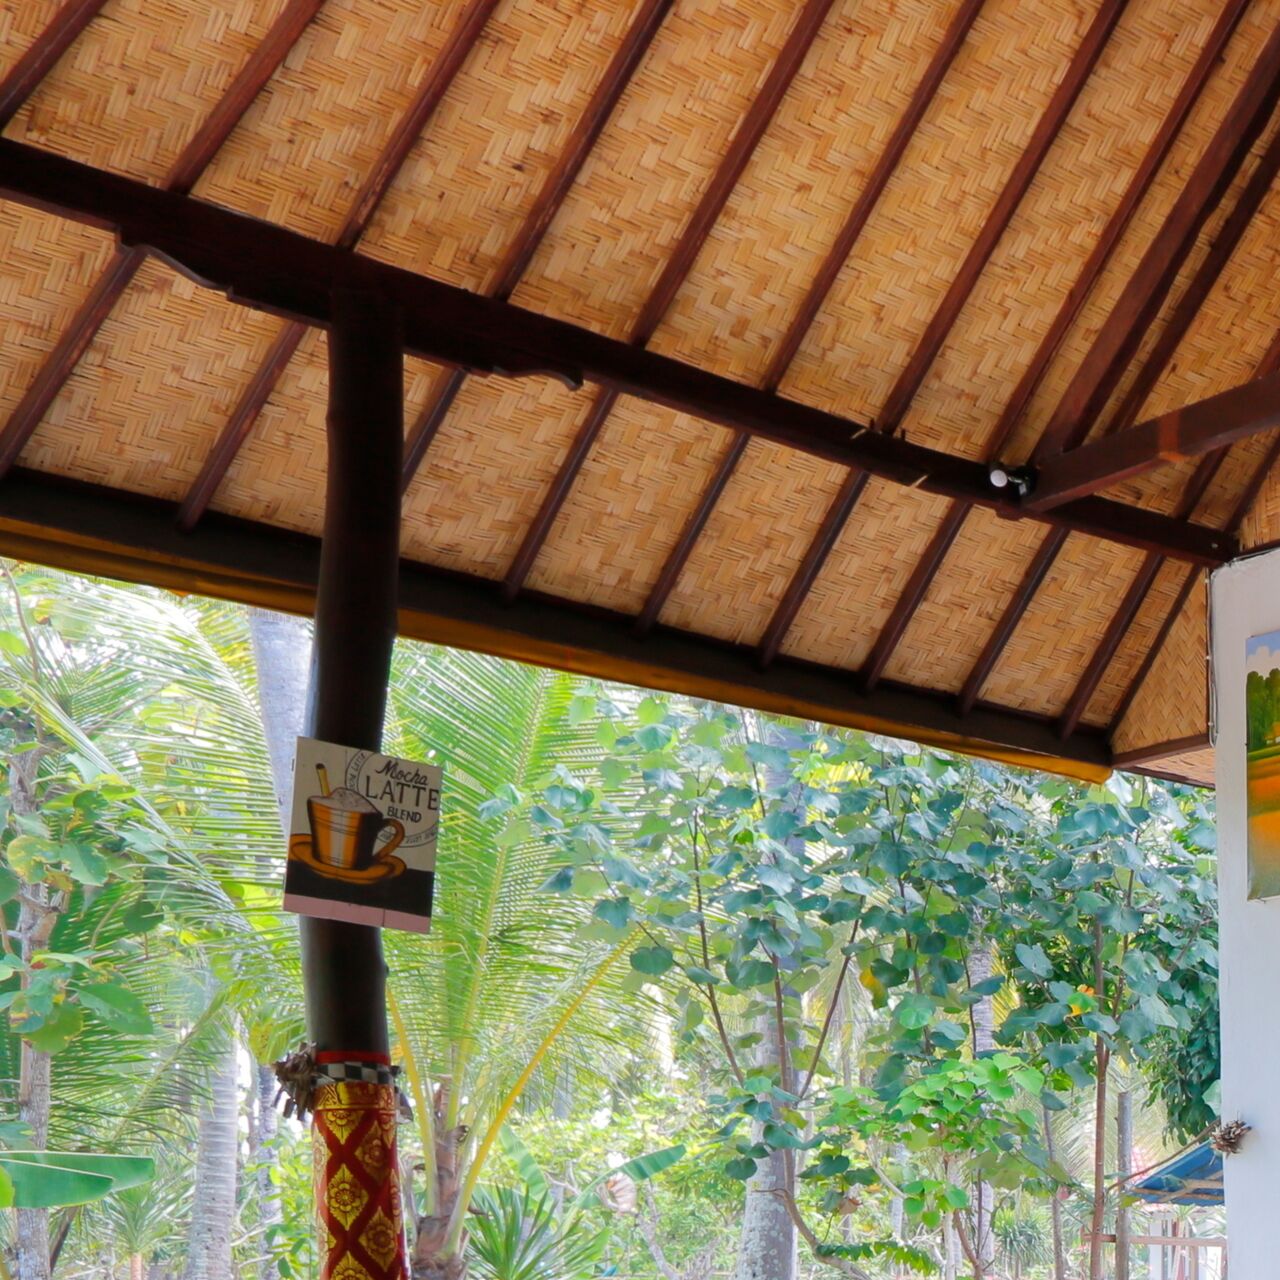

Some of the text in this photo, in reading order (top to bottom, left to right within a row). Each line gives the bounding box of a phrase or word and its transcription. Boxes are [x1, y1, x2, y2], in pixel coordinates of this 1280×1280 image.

[375, 760, 429, 786] Mocha
[365, 775, 440, 811] LATTE
[387, 806, 422, 824] BLEND
